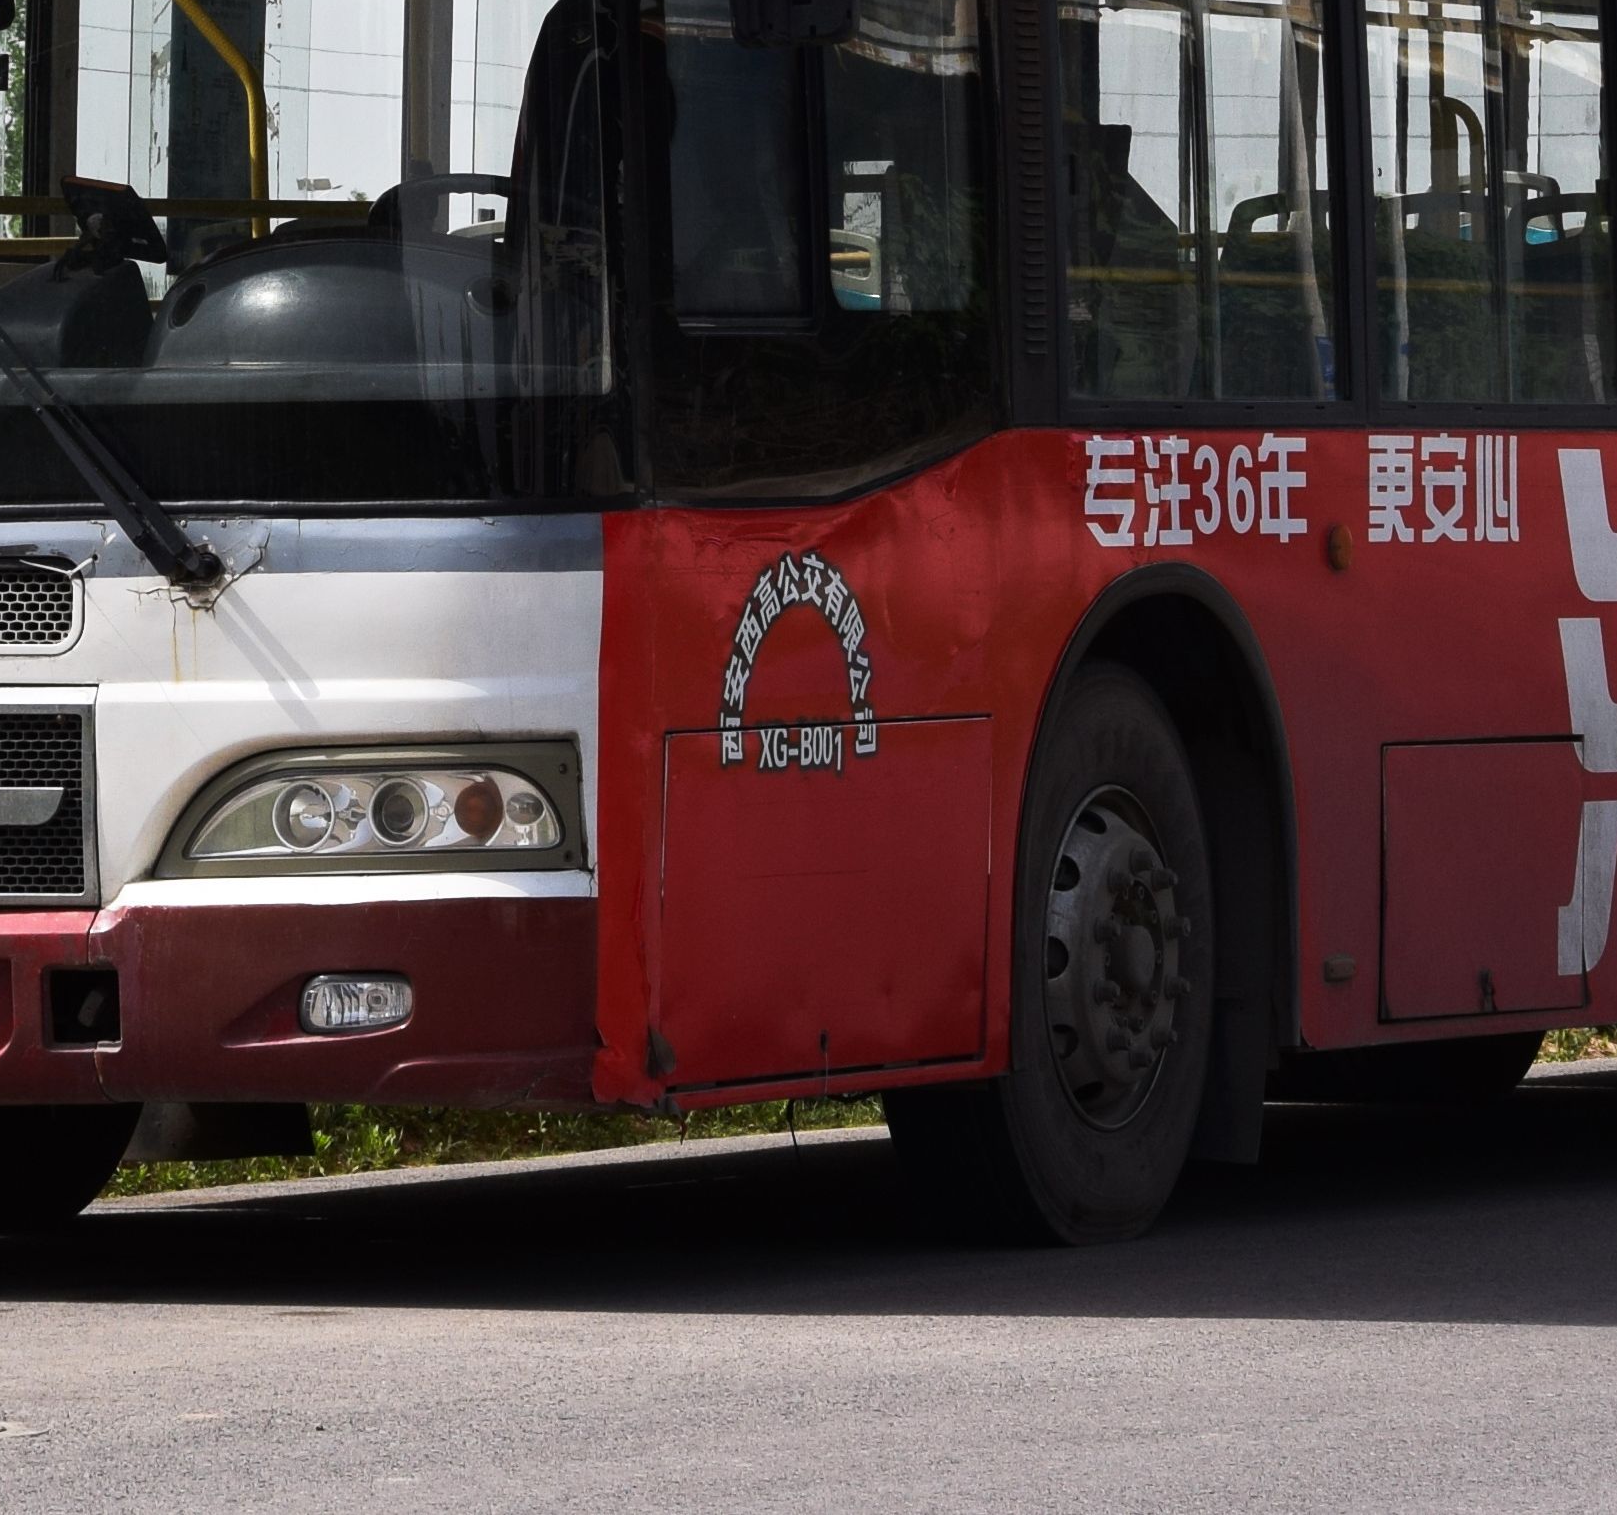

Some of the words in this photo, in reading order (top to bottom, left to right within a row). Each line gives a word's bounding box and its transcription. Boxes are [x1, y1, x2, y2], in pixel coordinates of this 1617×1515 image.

[1084, 433, 1308, 547] 专注36年
[1368, 433, 1520, 543] 更安心
[719, 553, 877, 765] 西安西高公交有限公司
[759, 726, 843, 771] XG-B001
